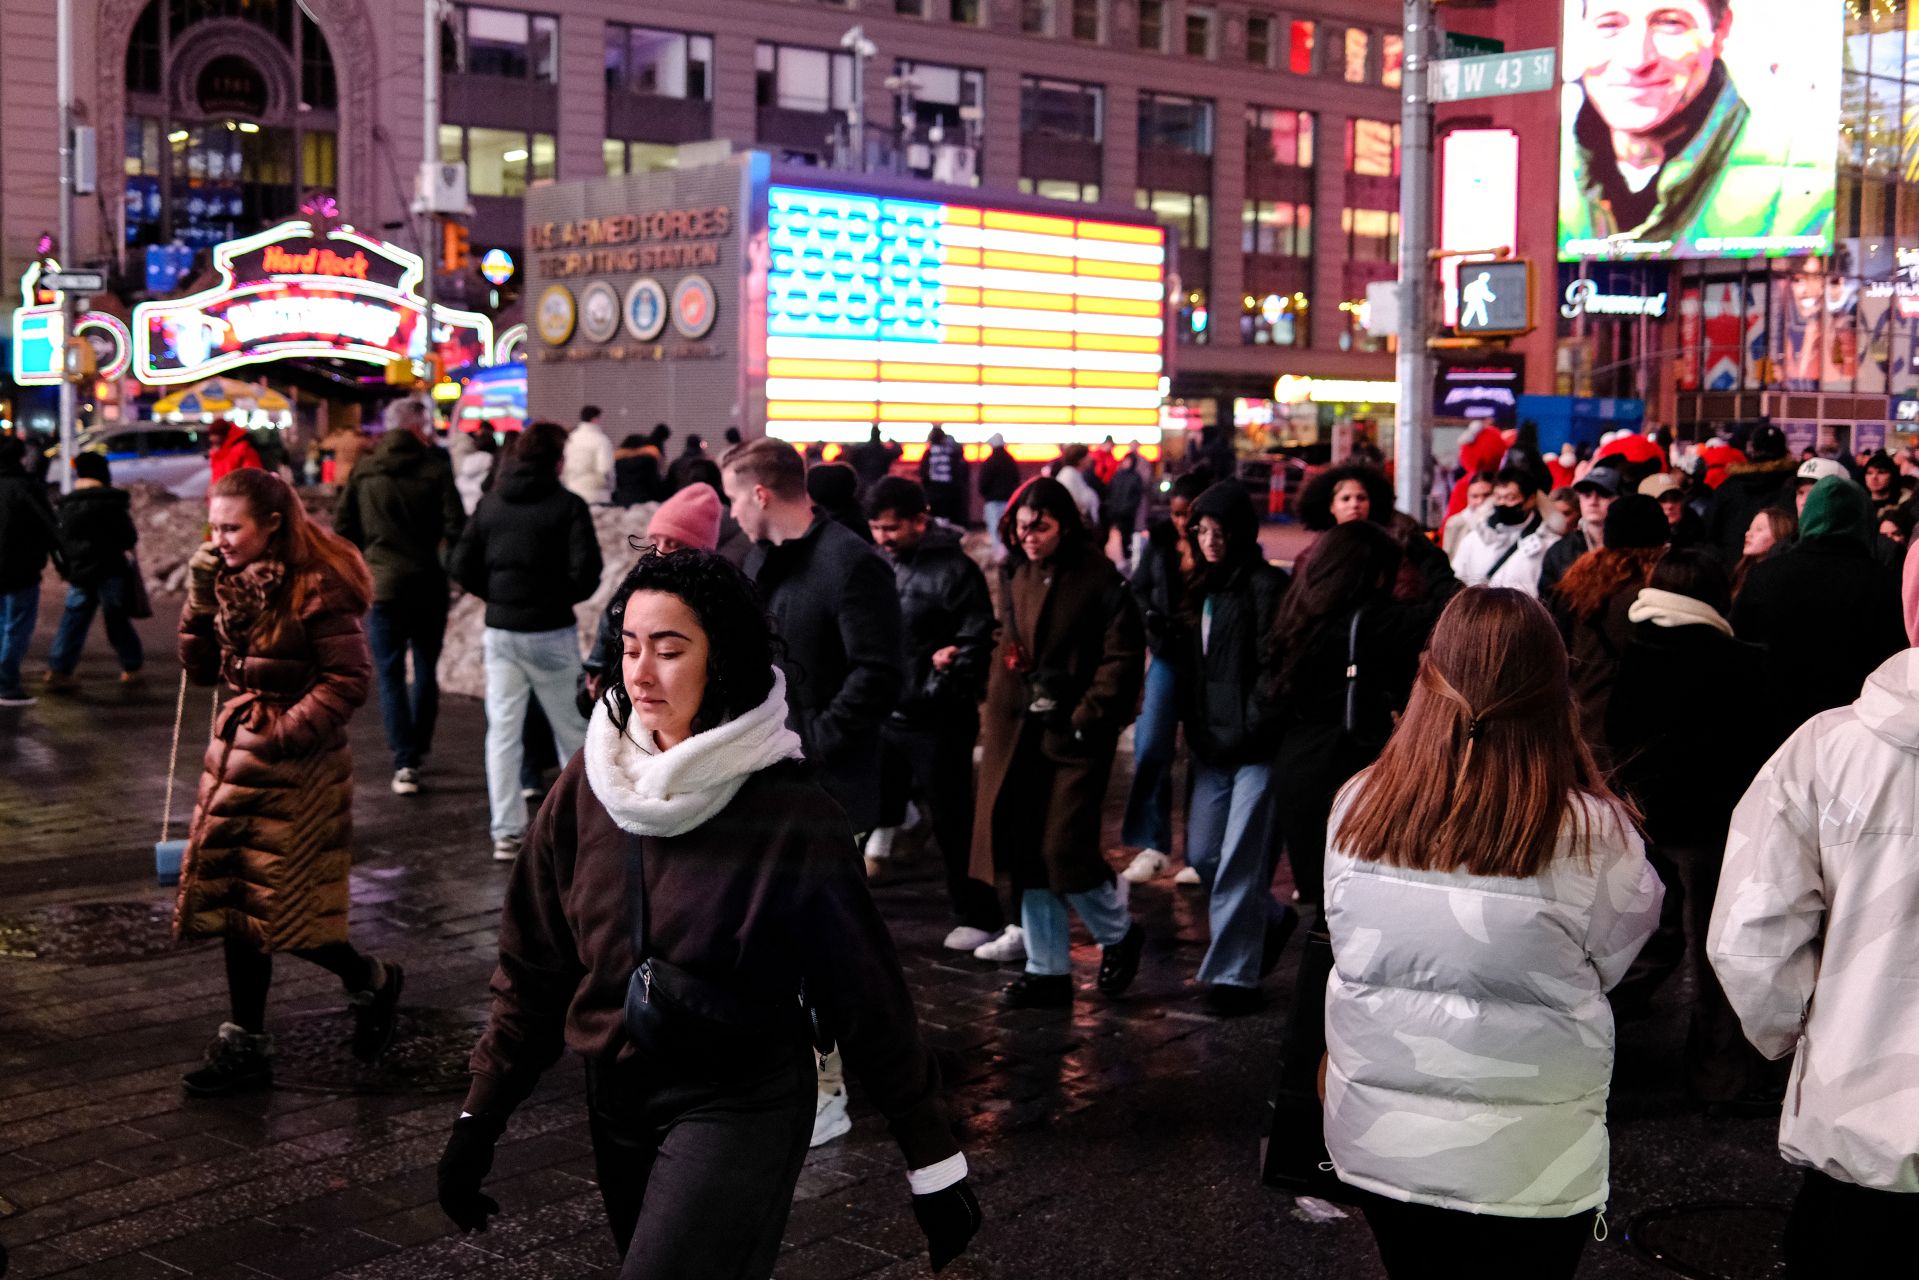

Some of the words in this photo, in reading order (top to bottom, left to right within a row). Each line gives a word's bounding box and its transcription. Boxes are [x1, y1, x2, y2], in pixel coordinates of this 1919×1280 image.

[1463, 62, 1485, 93] W
[1494, 57, 1523, 90] 43
[561, 213, 639, 246] ARMED
[640, 206, 730, 241] FORCES
[262, 245, 319, 274] Hard
[316, 249, 369, 281] Rock
